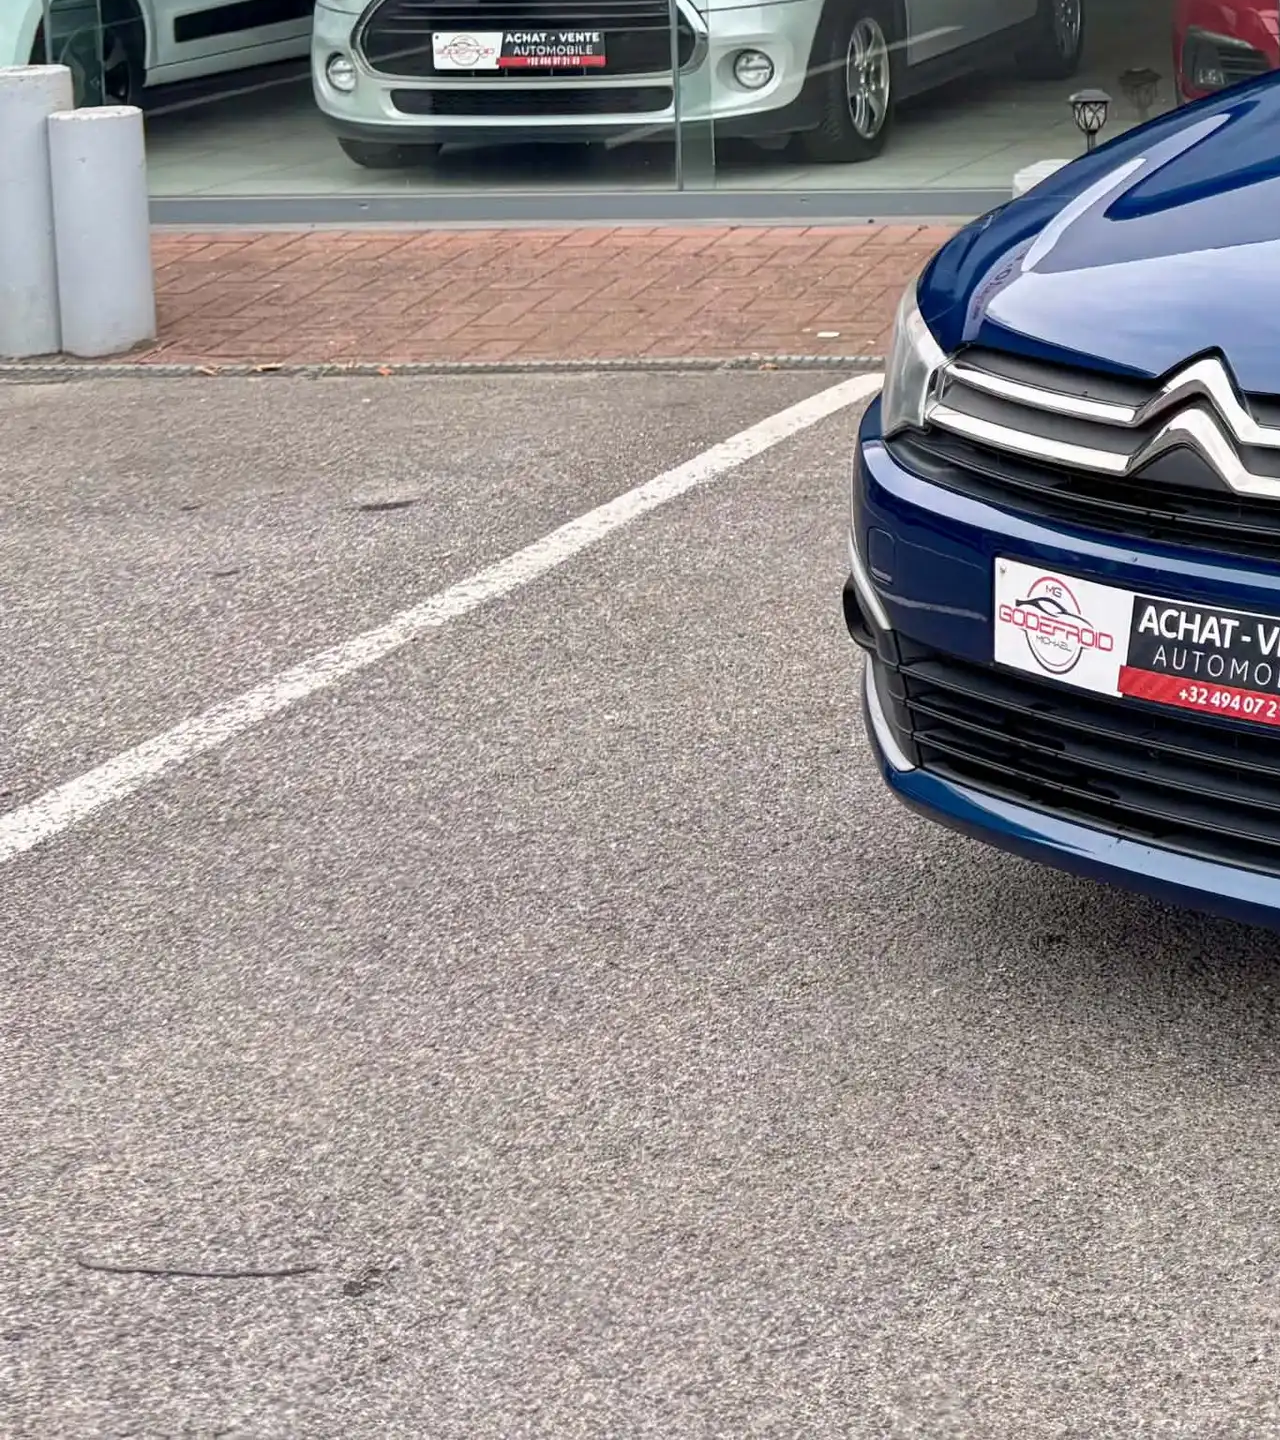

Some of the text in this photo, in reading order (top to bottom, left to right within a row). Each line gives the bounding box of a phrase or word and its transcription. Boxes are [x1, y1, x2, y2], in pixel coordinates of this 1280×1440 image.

[505, 32, 547, 43] ACHAT
[559, 32, 600, 43] VENTE
[513, 45, 593, 56] AUTOMOBILE
[999, 603, 1114, 652] GODEFROID
[1138, 604, 1240, 649] ACHAT
[1178, 685, 1208, 705] +32
[1210, 690, 1241, 710] 494
[1242, 696, 1261, 714] 07
